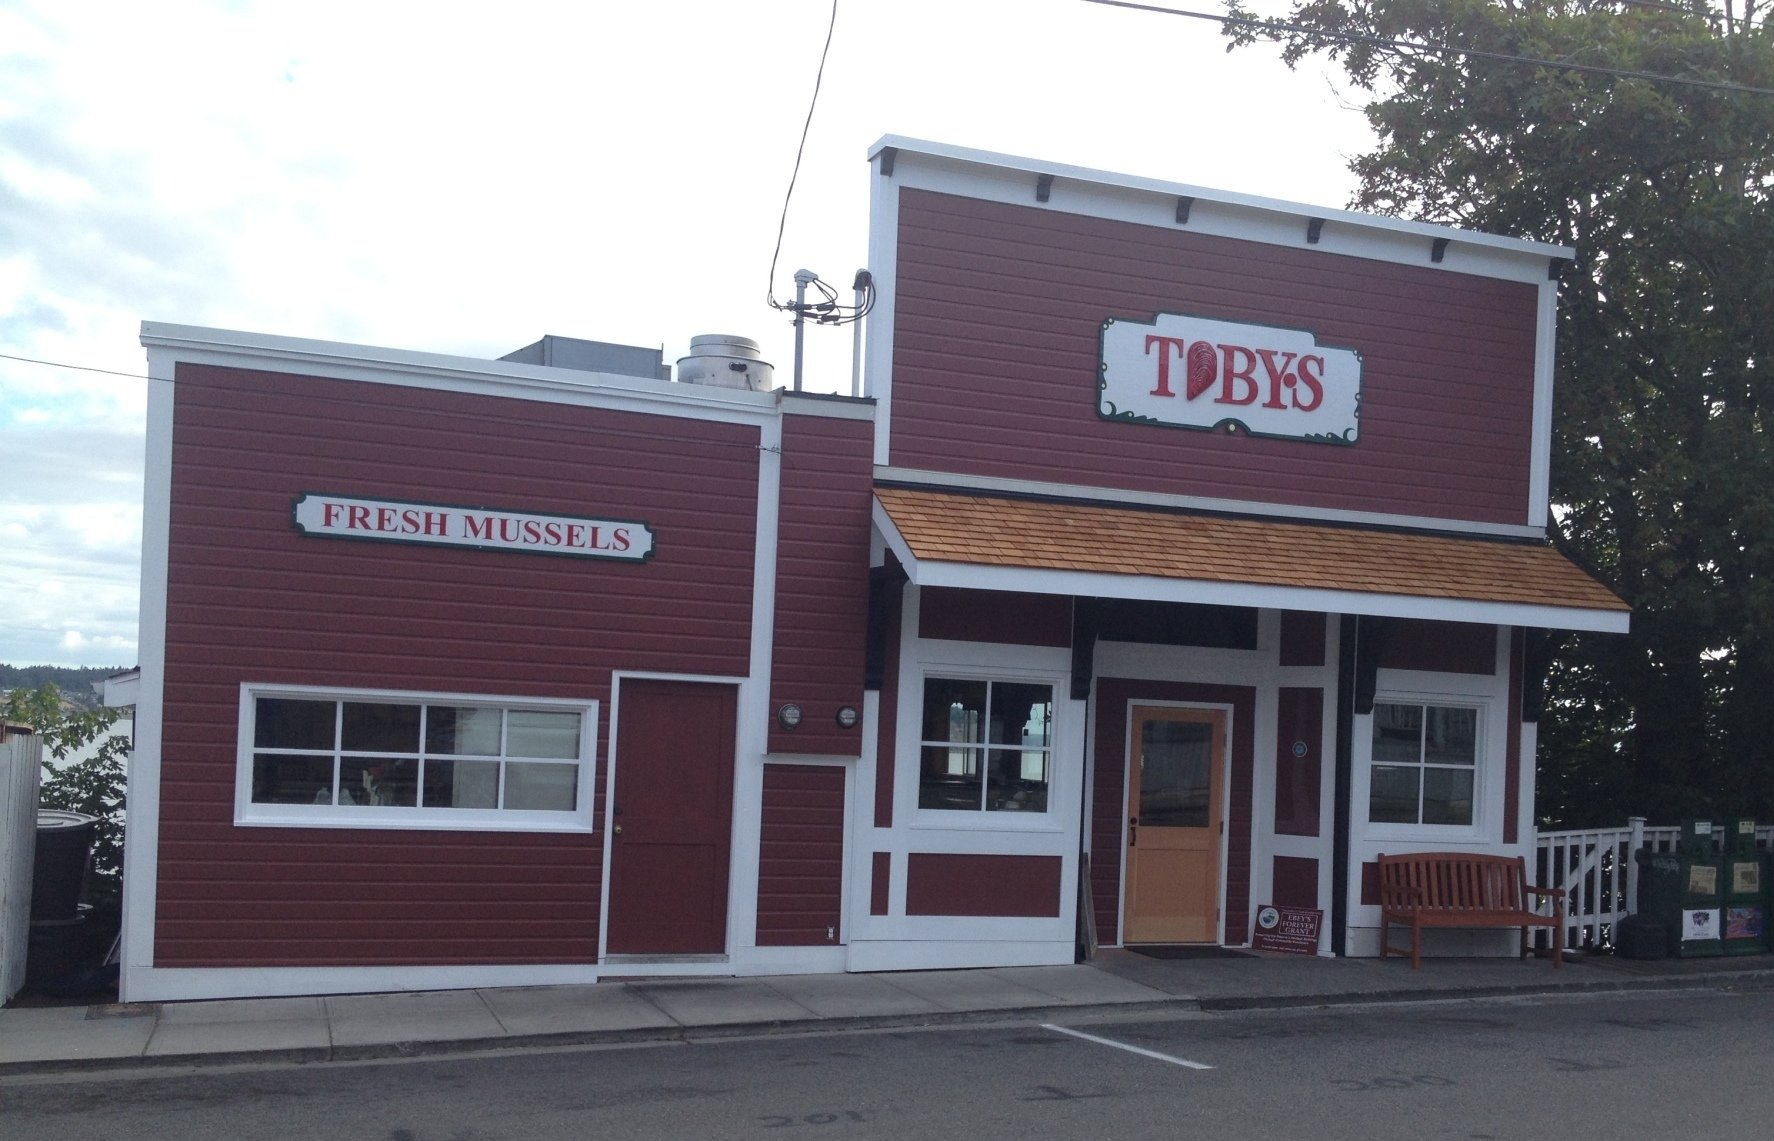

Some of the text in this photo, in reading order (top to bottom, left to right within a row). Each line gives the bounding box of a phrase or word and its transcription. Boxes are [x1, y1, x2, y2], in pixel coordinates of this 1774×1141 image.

[322, 503, 631, 552] FRESH MUSSELS
[1282, 920, 1314, 929] FOREVER
[1285, 927, 1310, 935] GRANT
